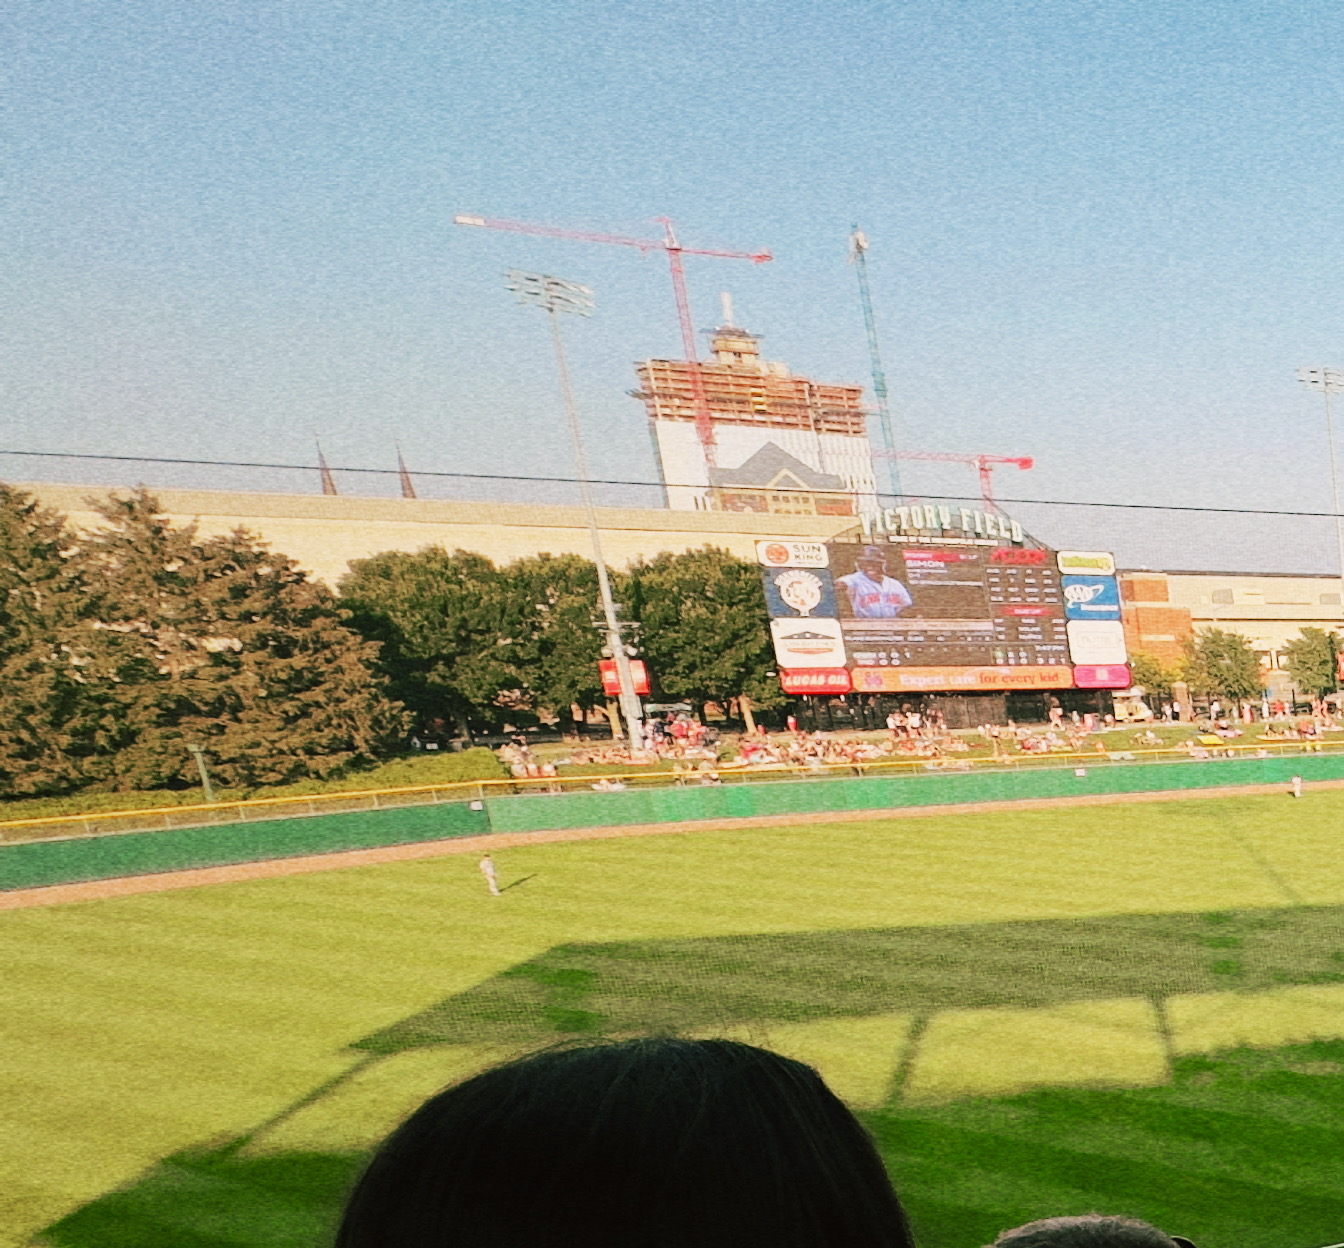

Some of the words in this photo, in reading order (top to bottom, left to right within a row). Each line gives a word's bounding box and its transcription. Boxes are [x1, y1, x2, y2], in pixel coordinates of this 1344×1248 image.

[859, 504, 952, 536] VICTORY
[959, 507, 1024, 543] FIELD
[792, 544, 821, 553] SUN
[794, 554, 823, 562] KING
[785, 674, 825, 686] LUCAS
[828, 674, 848, 685] OIL
[979, 673, 997, 684] for
[1002, 674, 1036, 685] every
[1040, 672, 1060, 683] kid
